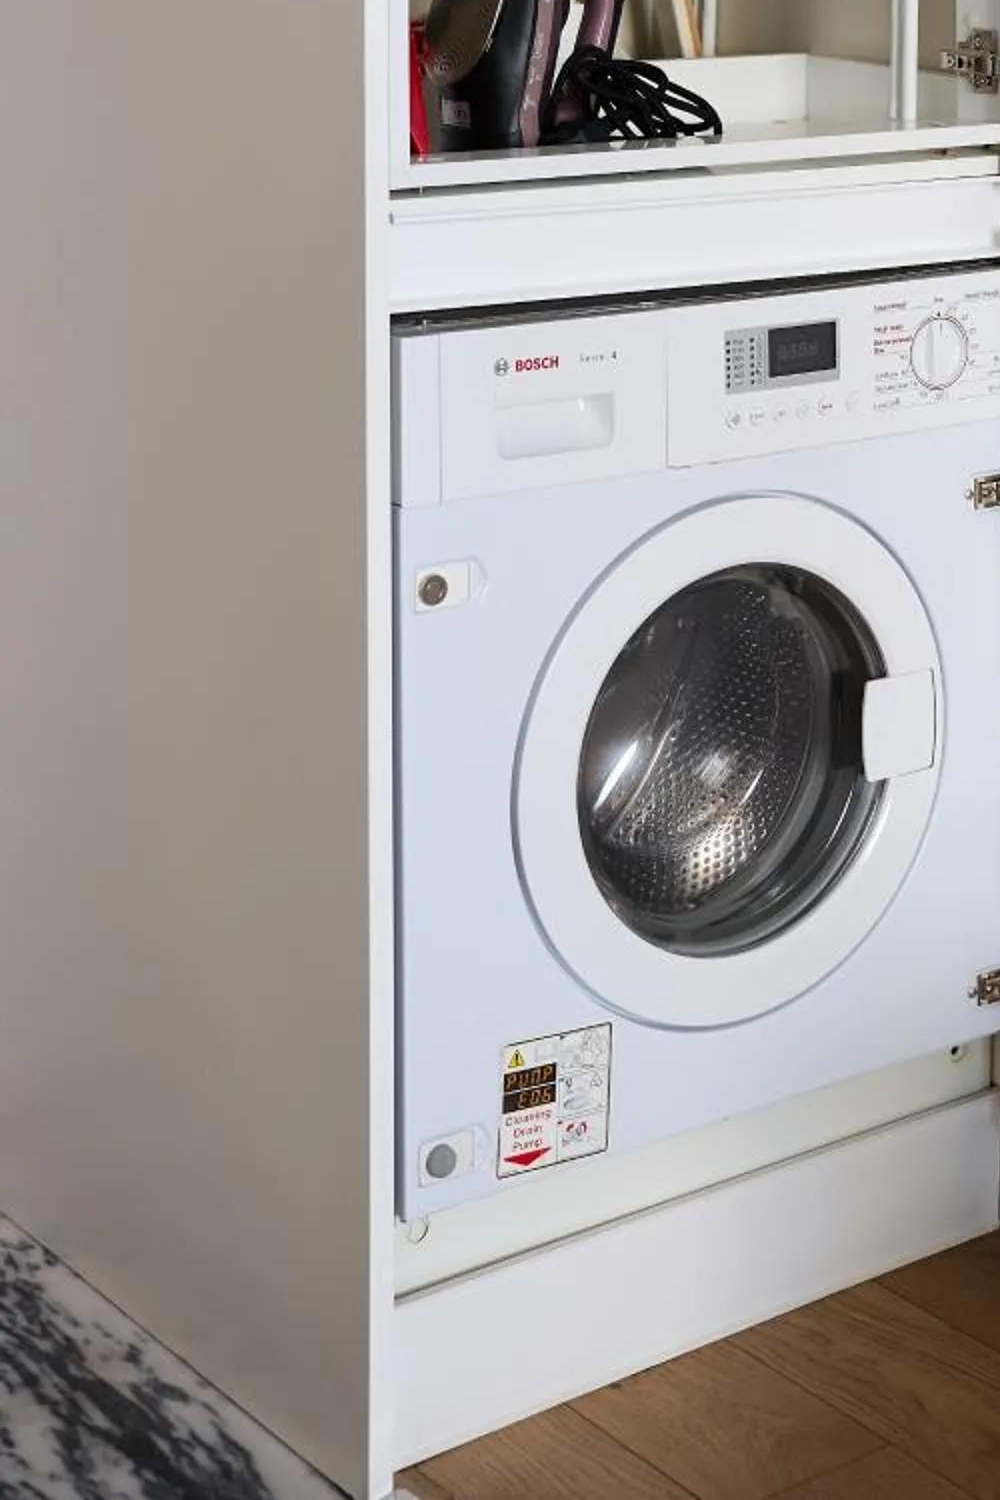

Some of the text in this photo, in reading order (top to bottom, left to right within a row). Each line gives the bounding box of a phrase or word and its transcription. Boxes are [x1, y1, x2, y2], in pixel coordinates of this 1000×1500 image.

[514, 355, 560, 373] BOSCH
[505, 1109, 552, 1127] Cleaning
[512, 1125, 544, 1139] Drain
[512, 1138, 544, 1151] Pump
